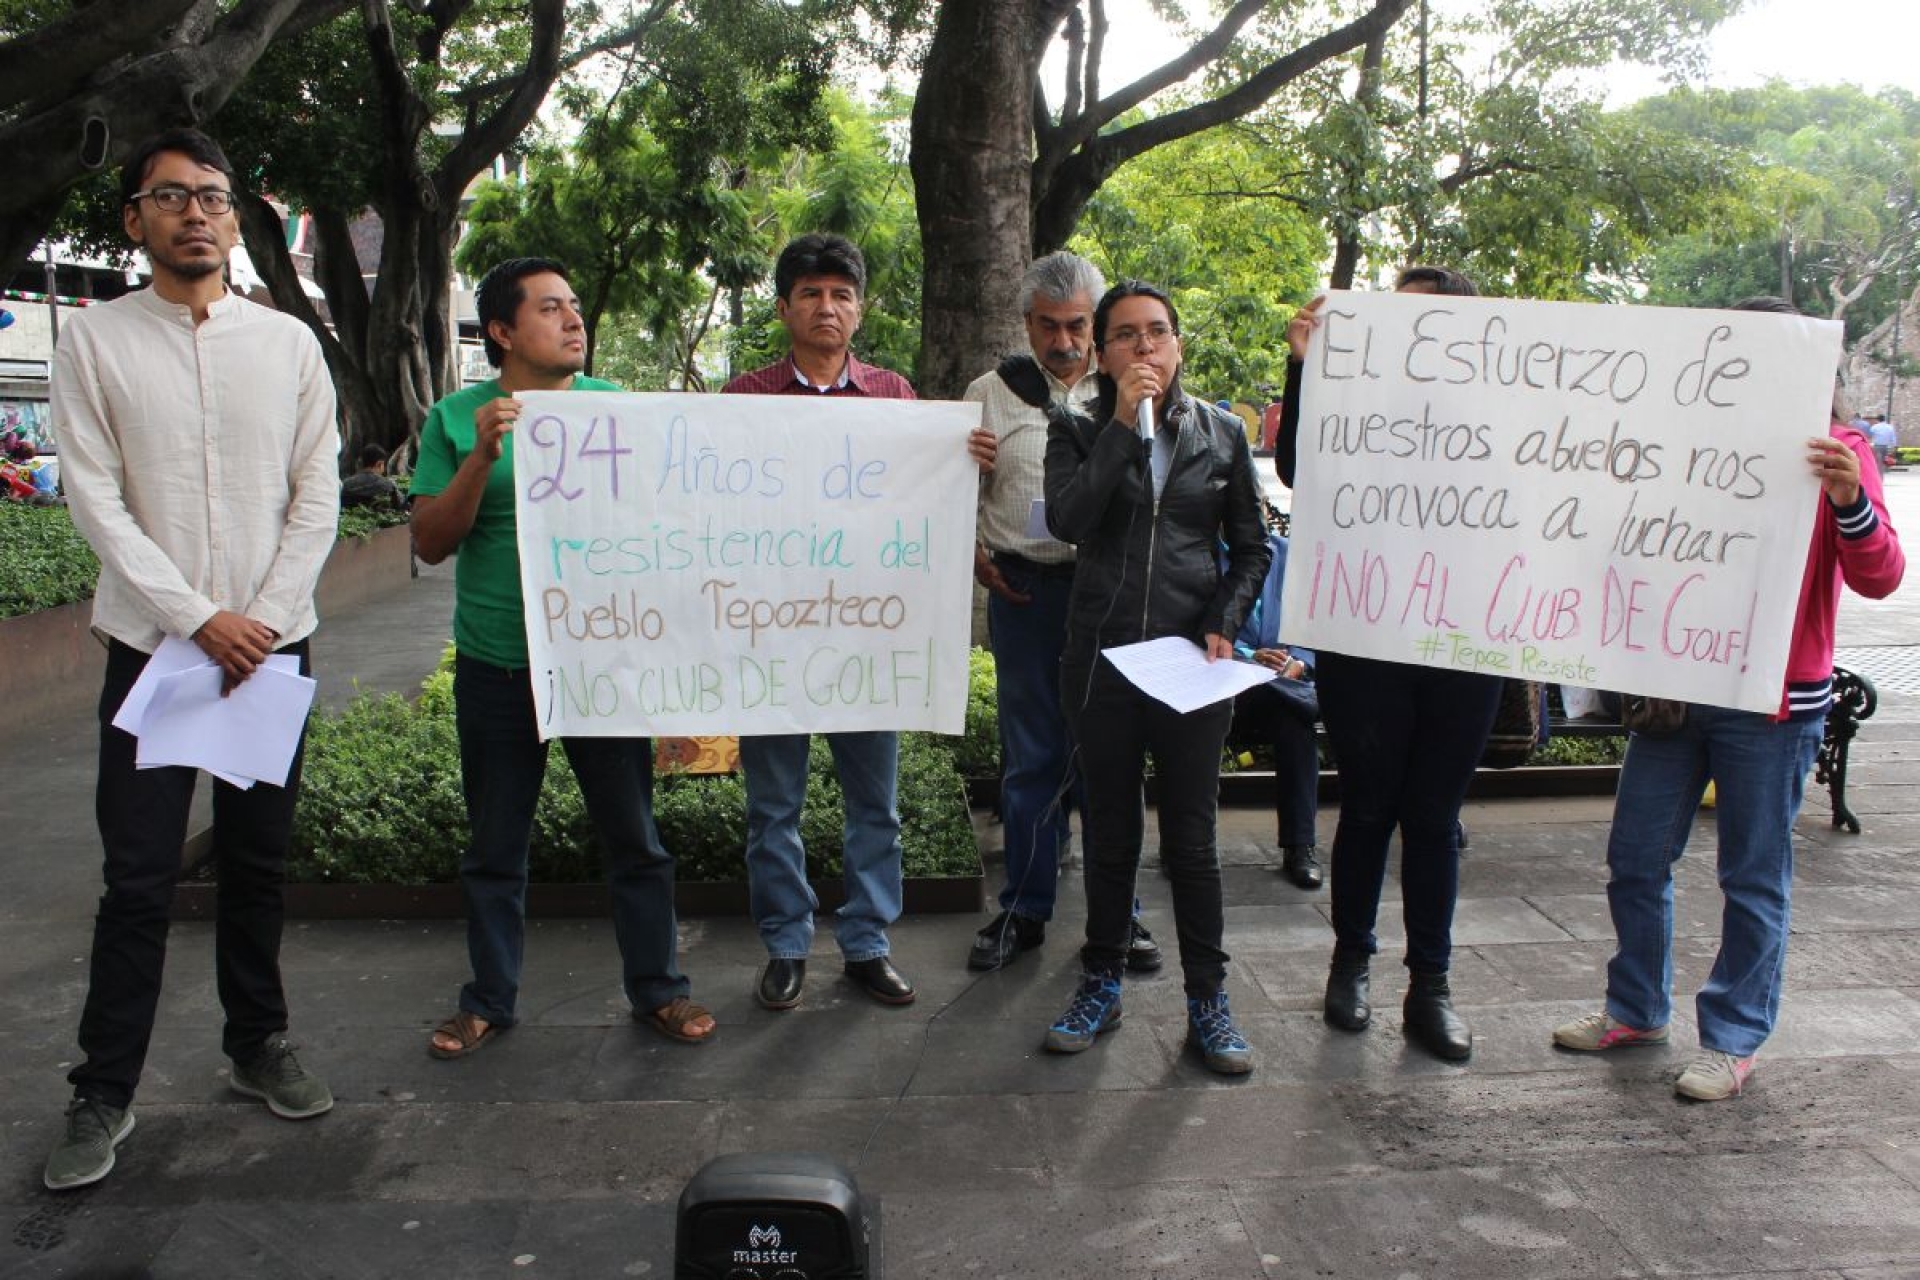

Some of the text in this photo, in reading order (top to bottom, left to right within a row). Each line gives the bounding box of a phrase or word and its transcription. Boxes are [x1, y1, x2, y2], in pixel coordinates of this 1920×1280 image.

[1404, 309, 1649, 404] Esfuerzo
[1673, 324, 1751, 408] de
[527, 414, 888, 502] 24 Años de
[1317, 400, 1492, 463] nuestros
[1685, 446, 1766, 500] nos
[551, 515, 931, 580] resistencia del
[1331, 483, 1757, 565] convoca a luchar
[541, 578, 906, 648] Pueblo Tepozteco
[1307, 541, 1760, 674] ¡NO AL CLUB DE GOLF!
[546, 636, 935, 726] ¡NO CLUB DE GOLF!
[1415, 632, 1598, 684] #Tepoz Resiste
[733, 1250, 798, 1264] master
